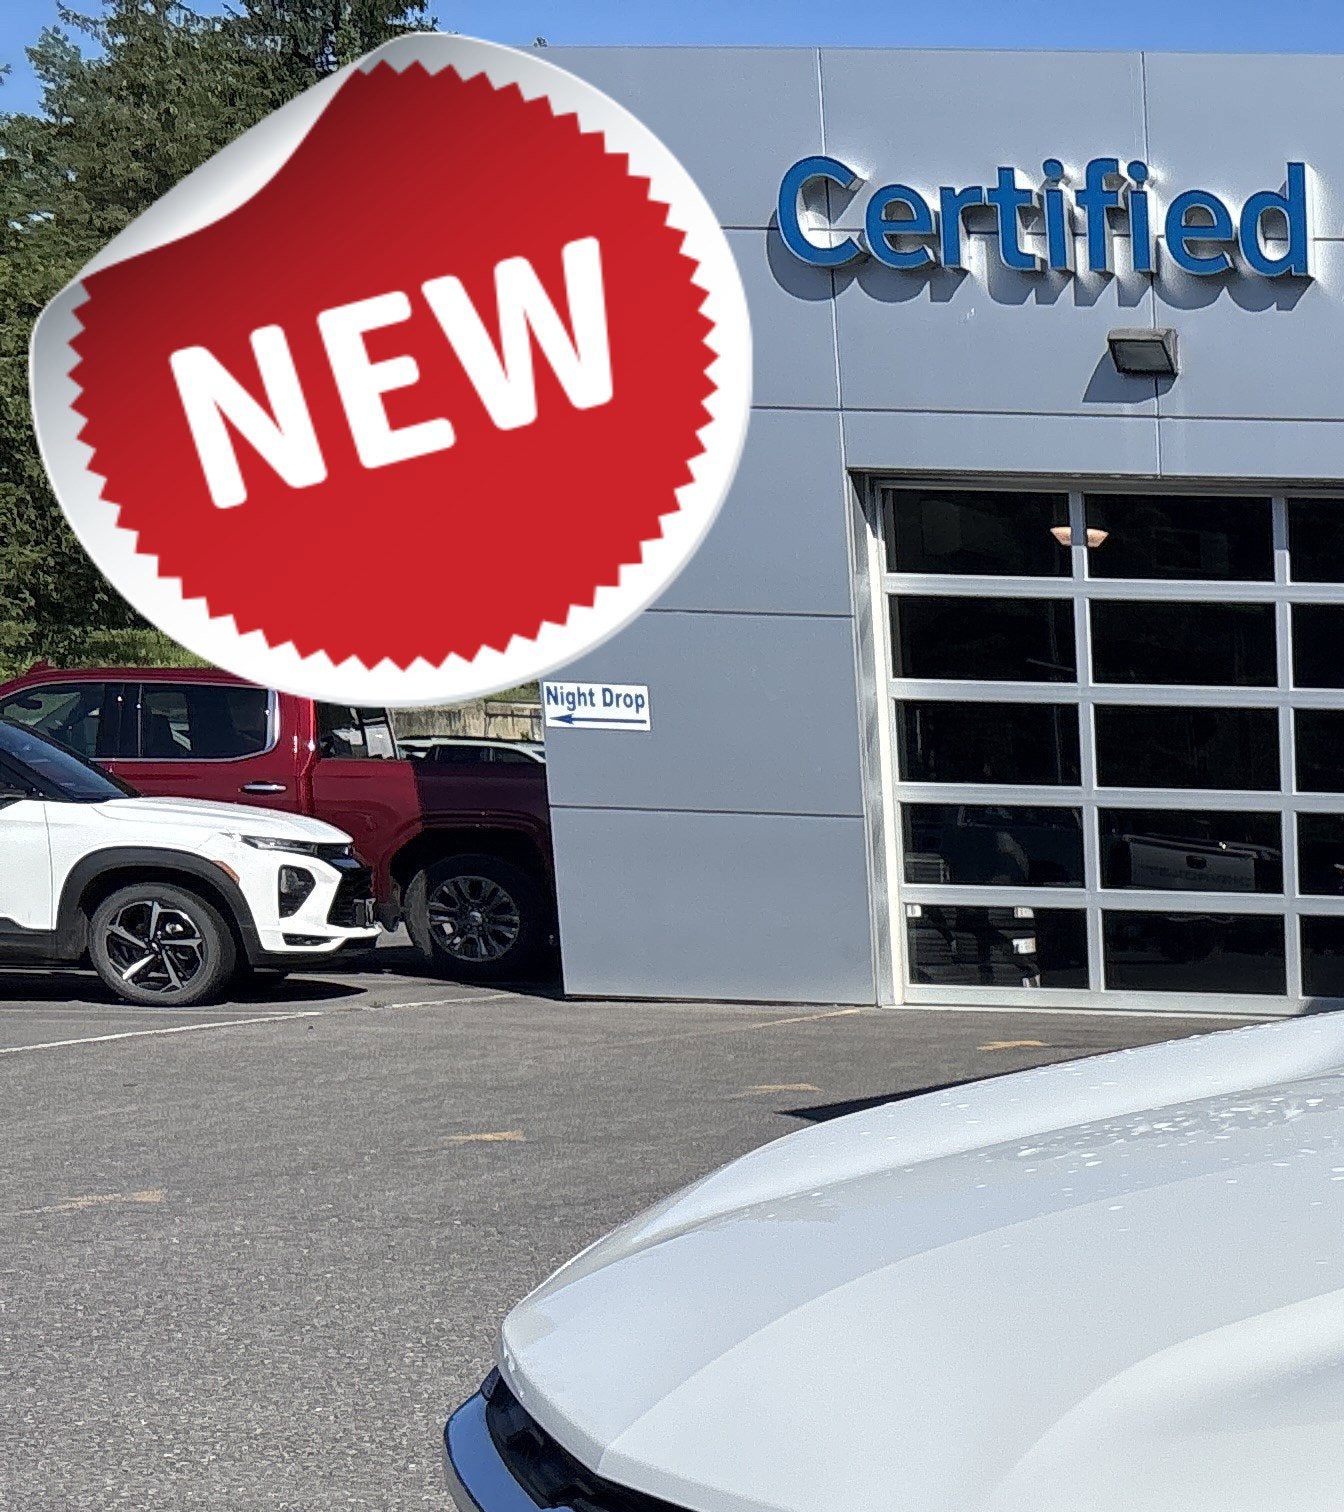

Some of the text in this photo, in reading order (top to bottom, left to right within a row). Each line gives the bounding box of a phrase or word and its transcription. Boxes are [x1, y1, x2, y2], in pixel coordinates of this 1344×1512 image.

[777, 154, 1314, 278] Certified
[546, 685, 645, 714] Night Drop
